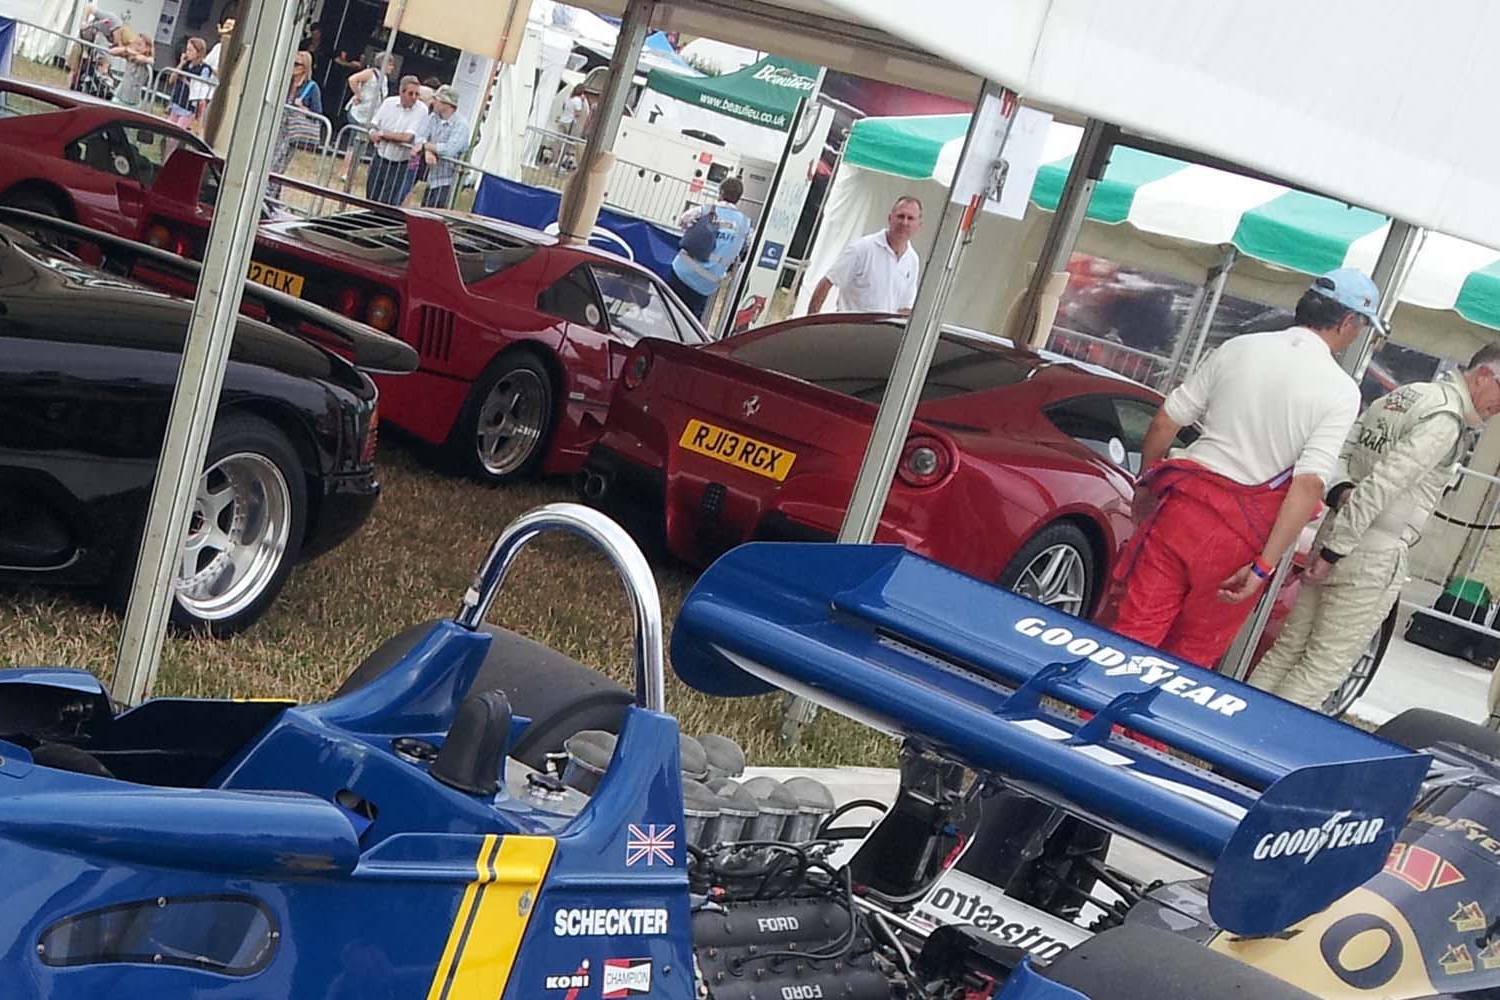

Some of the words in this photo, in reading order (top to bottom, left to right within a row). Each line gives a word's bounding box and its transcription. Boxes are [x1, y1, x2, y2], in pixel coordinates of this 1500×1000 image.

[700, 93, 786, 127] www.beaulieu.co.uk
[263, 269, 294, 295] CLK
[692, 425, 740, 458] RJ13
[758, 441, 783, 473] RGX
[1013, 616, 1249, 718] GOODYEAR
[1252, 810, 1386, 865] GOODYEAR
[553, 908, 669, 937] SCHECKTER
[757, 916, 800, 933] FORD
[546, 975, 590, 989] KONI
[604, 970, 649, 985] CHAMPION
[781, 984, 824, 1000] FORD
